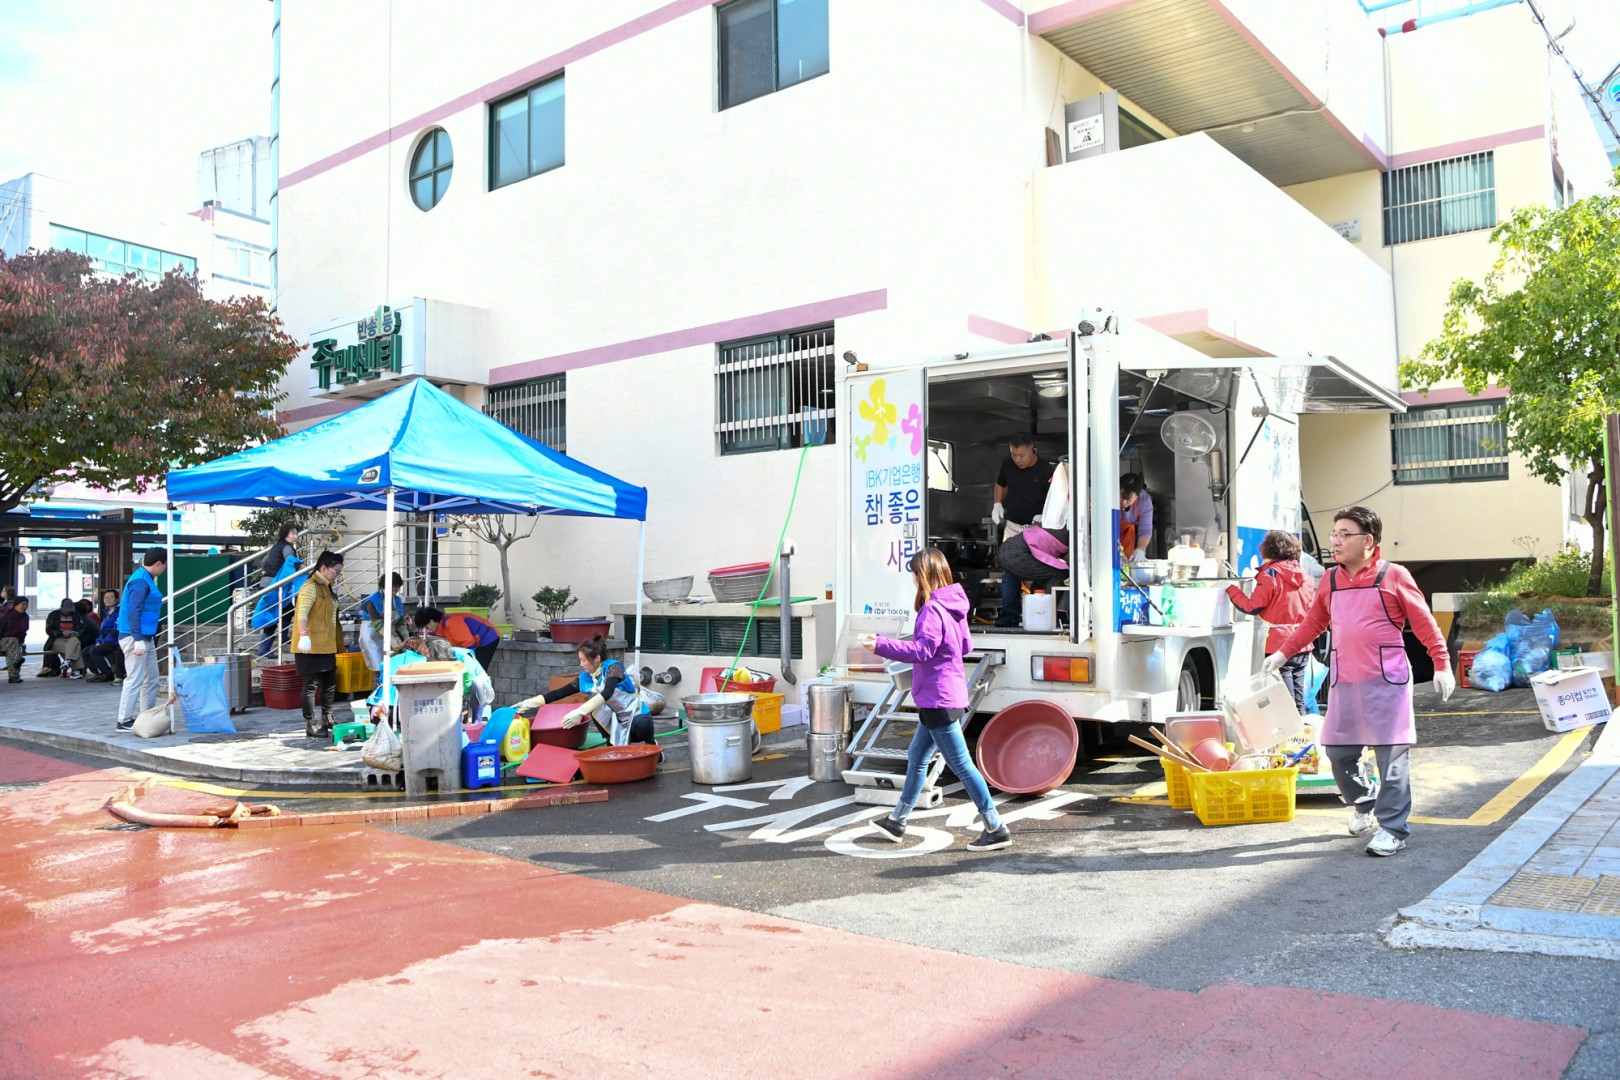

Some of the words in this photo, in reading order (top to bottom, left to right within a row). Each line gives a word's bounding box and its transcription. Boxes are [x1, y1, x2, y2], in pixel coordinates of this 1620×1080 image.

[311, 334, 402, 388] 주민센터
[866, 462, 920, 488] IBK기업은행
[887, 489, 920, 524] 좋은
[1557, 690, 1584, 706] 종이컵
